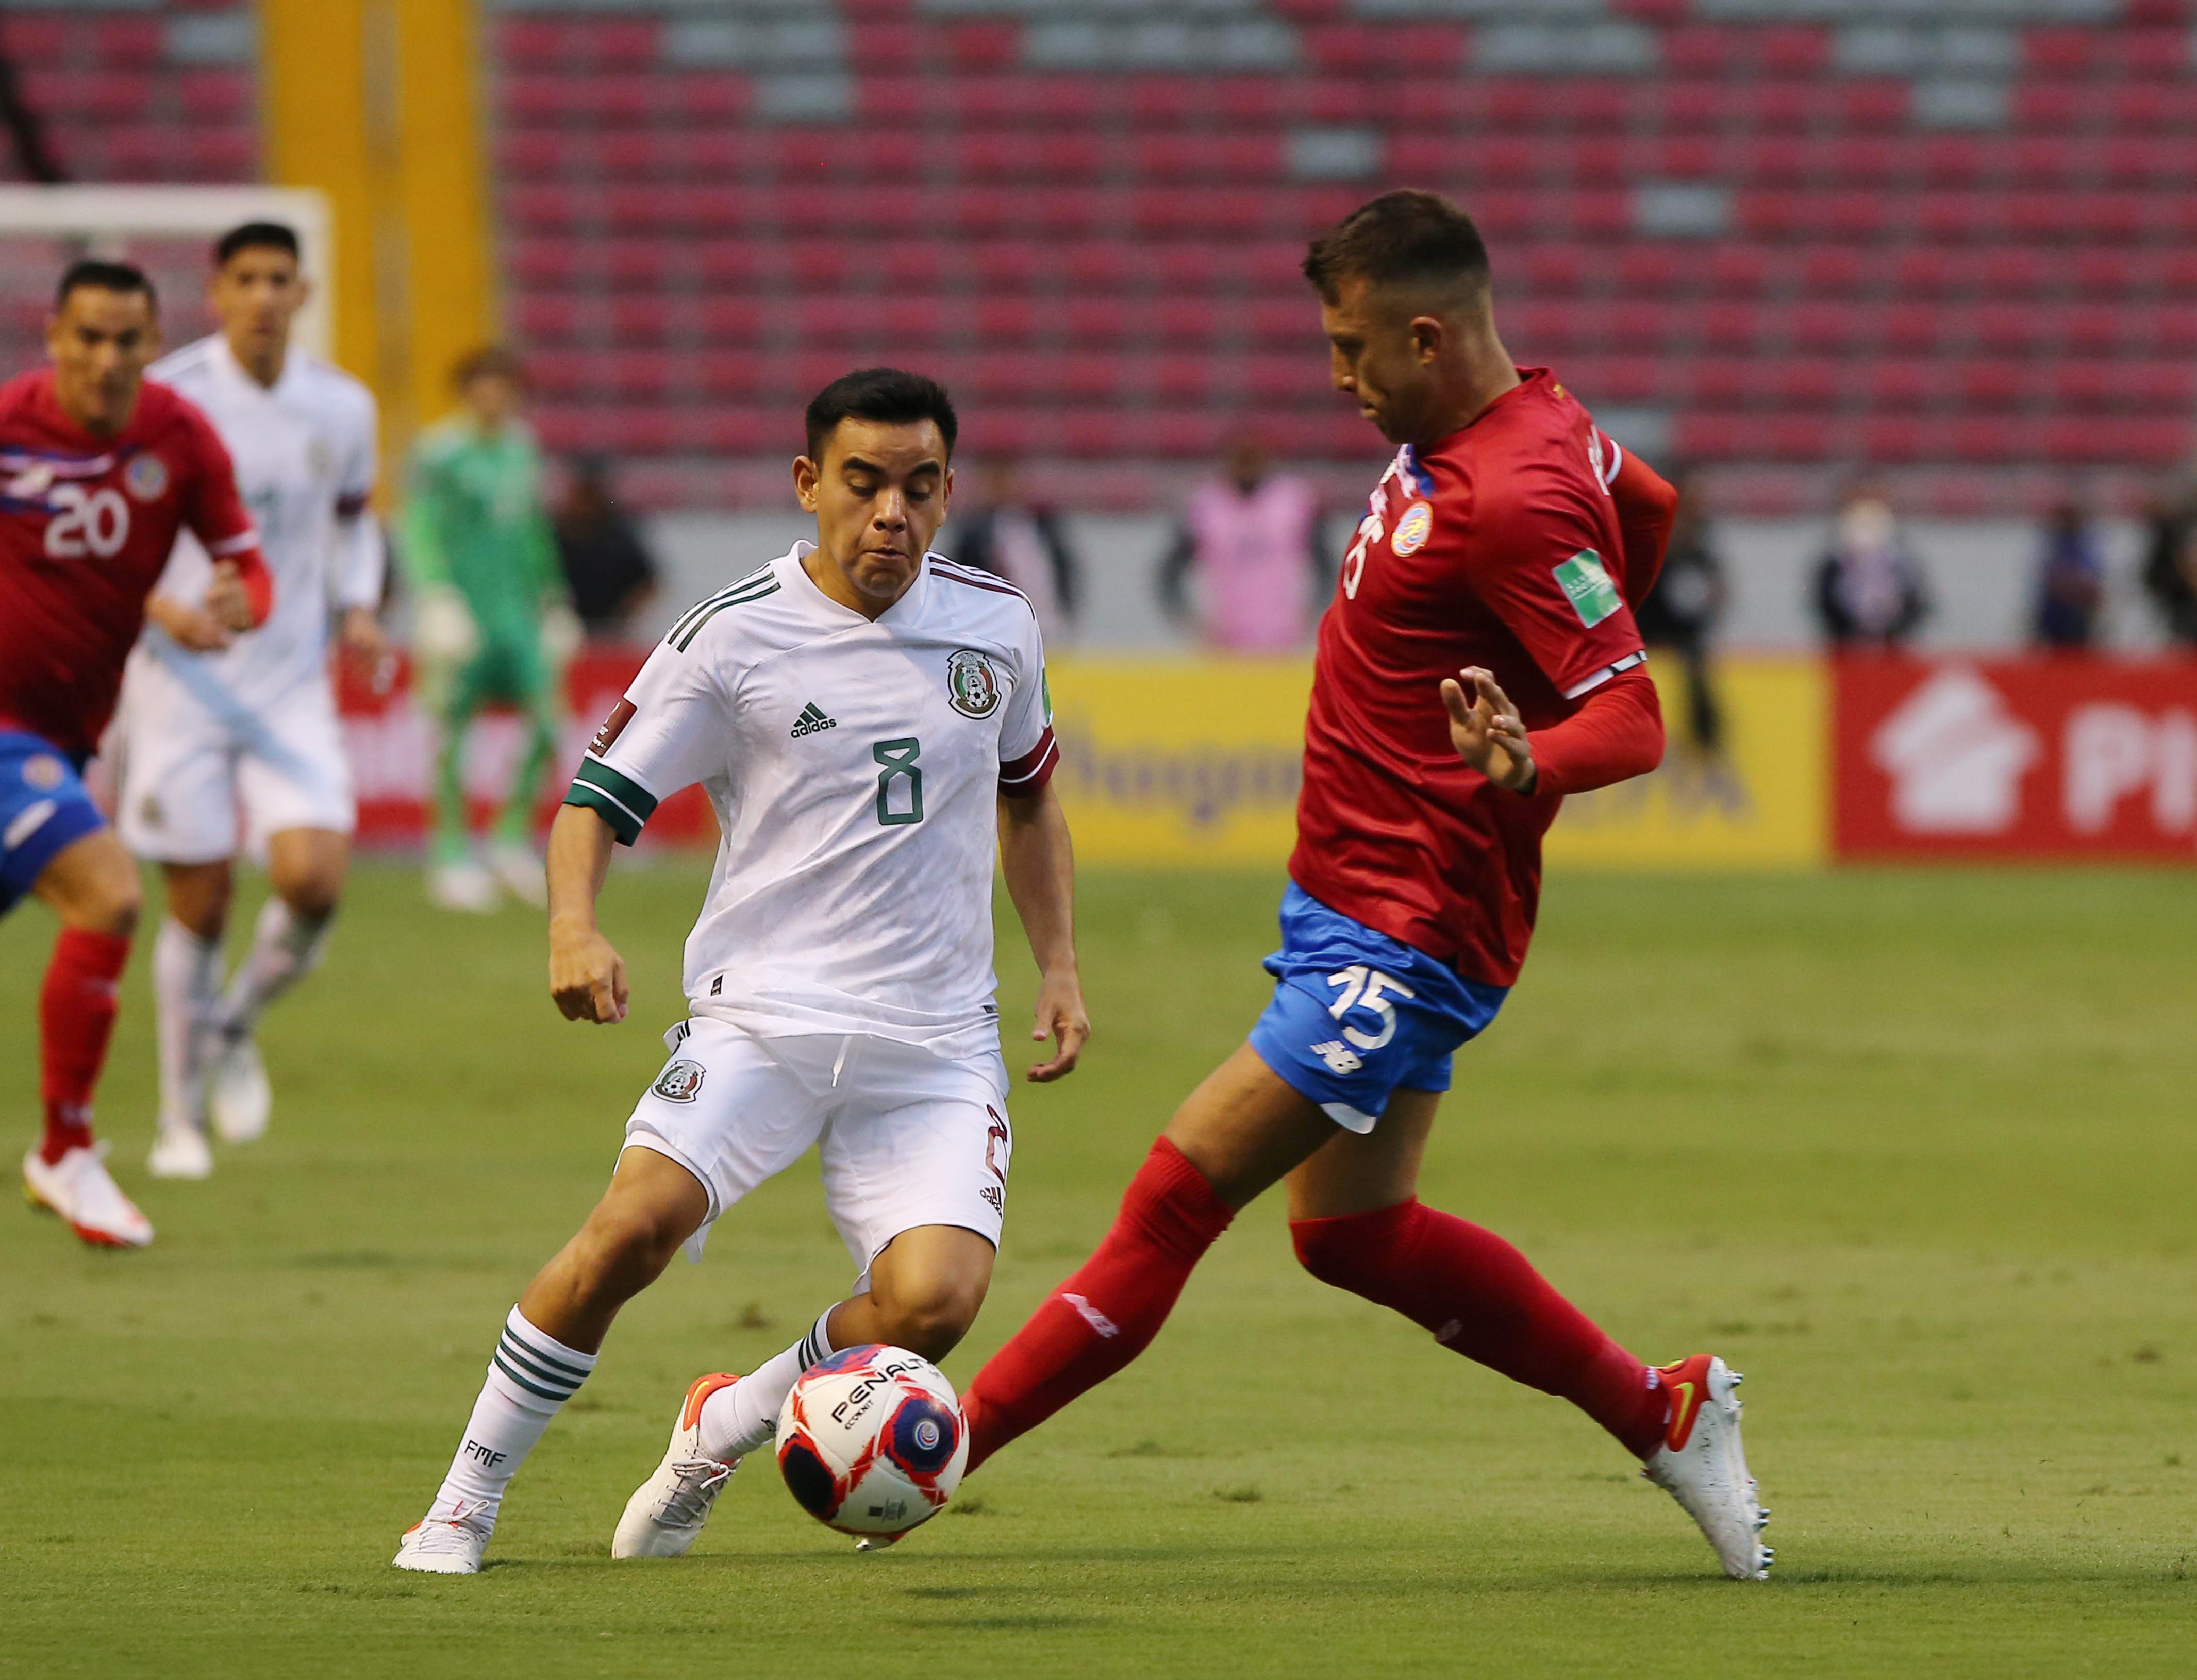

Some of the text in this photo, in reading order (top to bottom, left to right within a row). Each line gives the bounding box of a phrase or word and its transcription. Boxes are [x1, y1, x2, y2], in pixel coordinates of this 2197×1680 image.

[43, 483, 130, 557] 20
[791, 719, 837, 738] adidas
[873, 737, 923, 826] 8
[1327, 965, 1416, 1050] 15
[831, 1358, 930, 1423] PENALT
[464, 1439, 507, 1468] FMF
